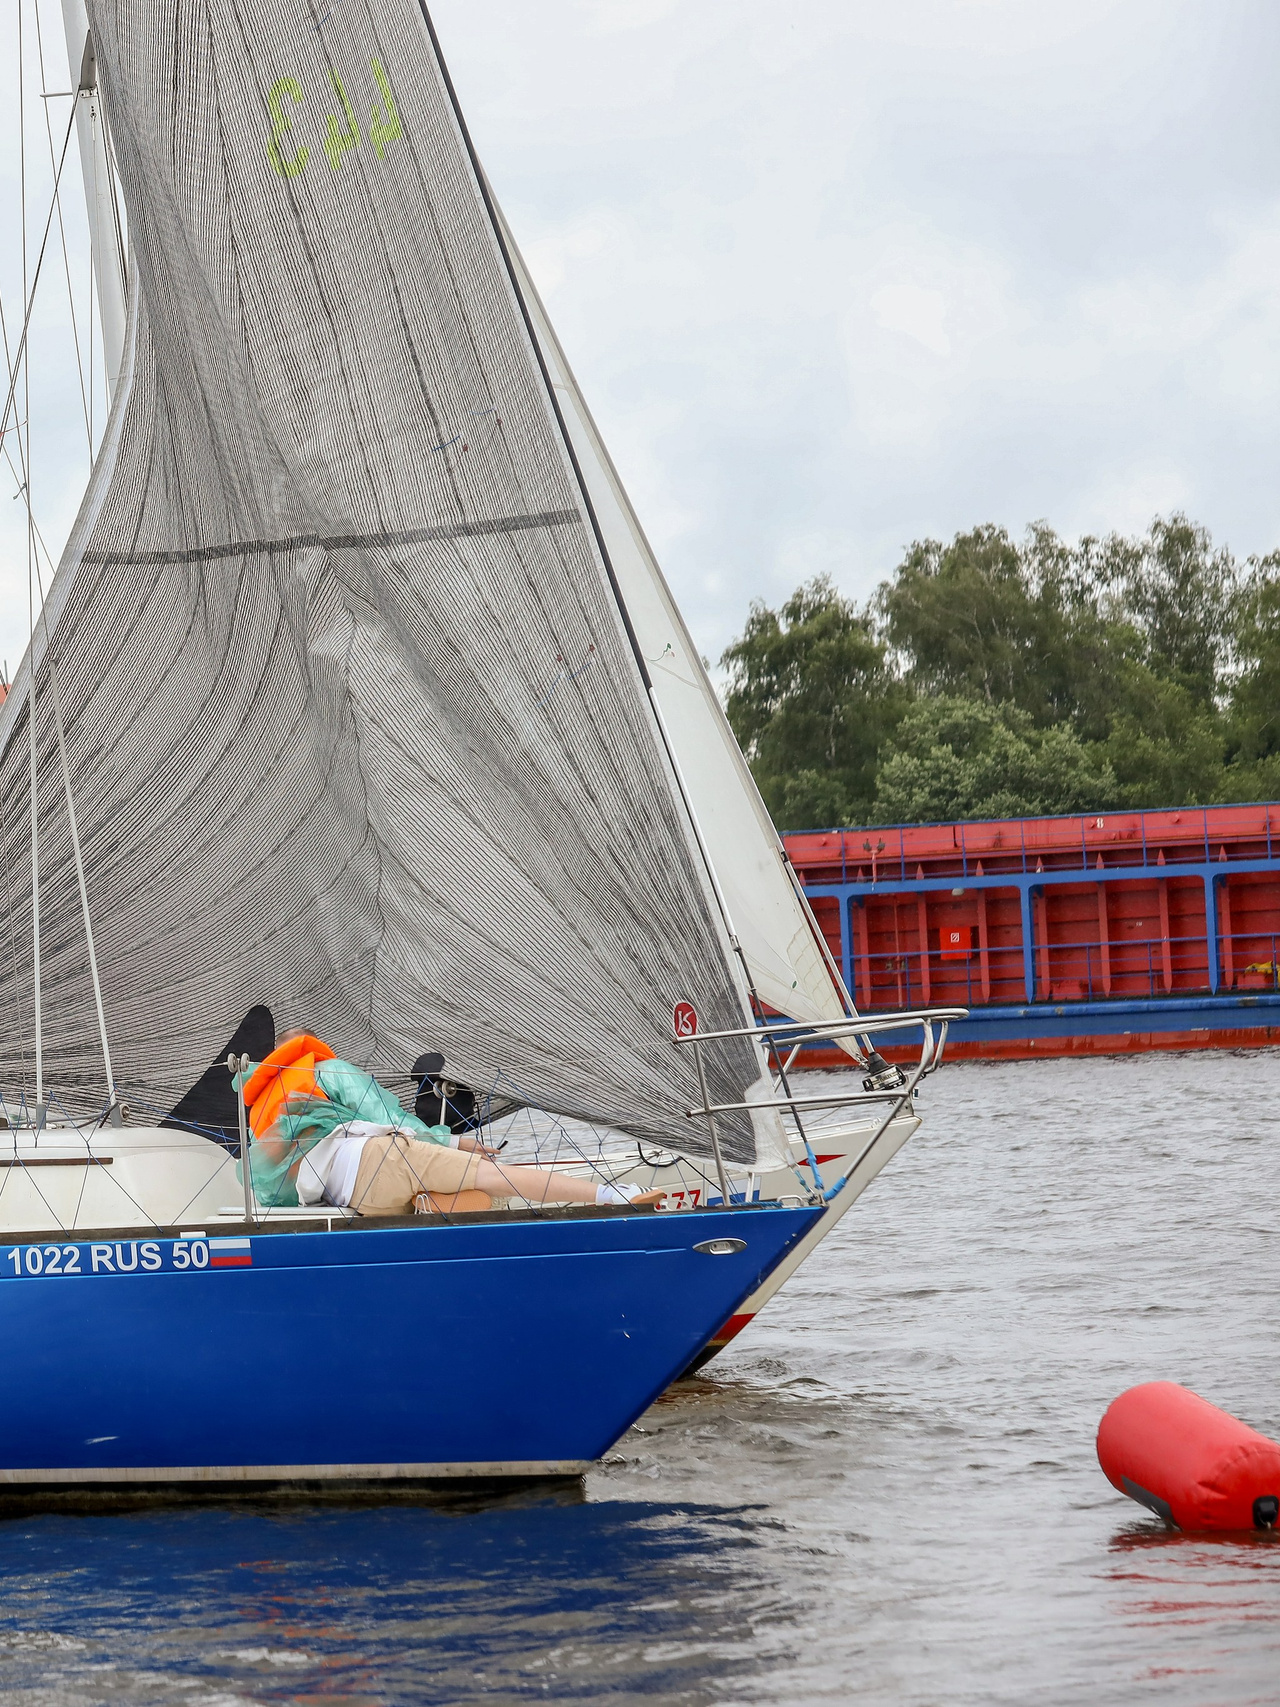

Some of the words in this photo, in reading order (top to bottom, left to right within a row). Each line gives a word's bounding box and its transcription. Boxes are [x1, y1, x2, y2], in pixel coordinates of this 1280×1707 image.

[1096, 817, 1104, 829] 8
[7, 1245, 81, 1275] 1022
[90, 1241, 162, 1272] RUS
[172, 1240, 209, 1268] 50
